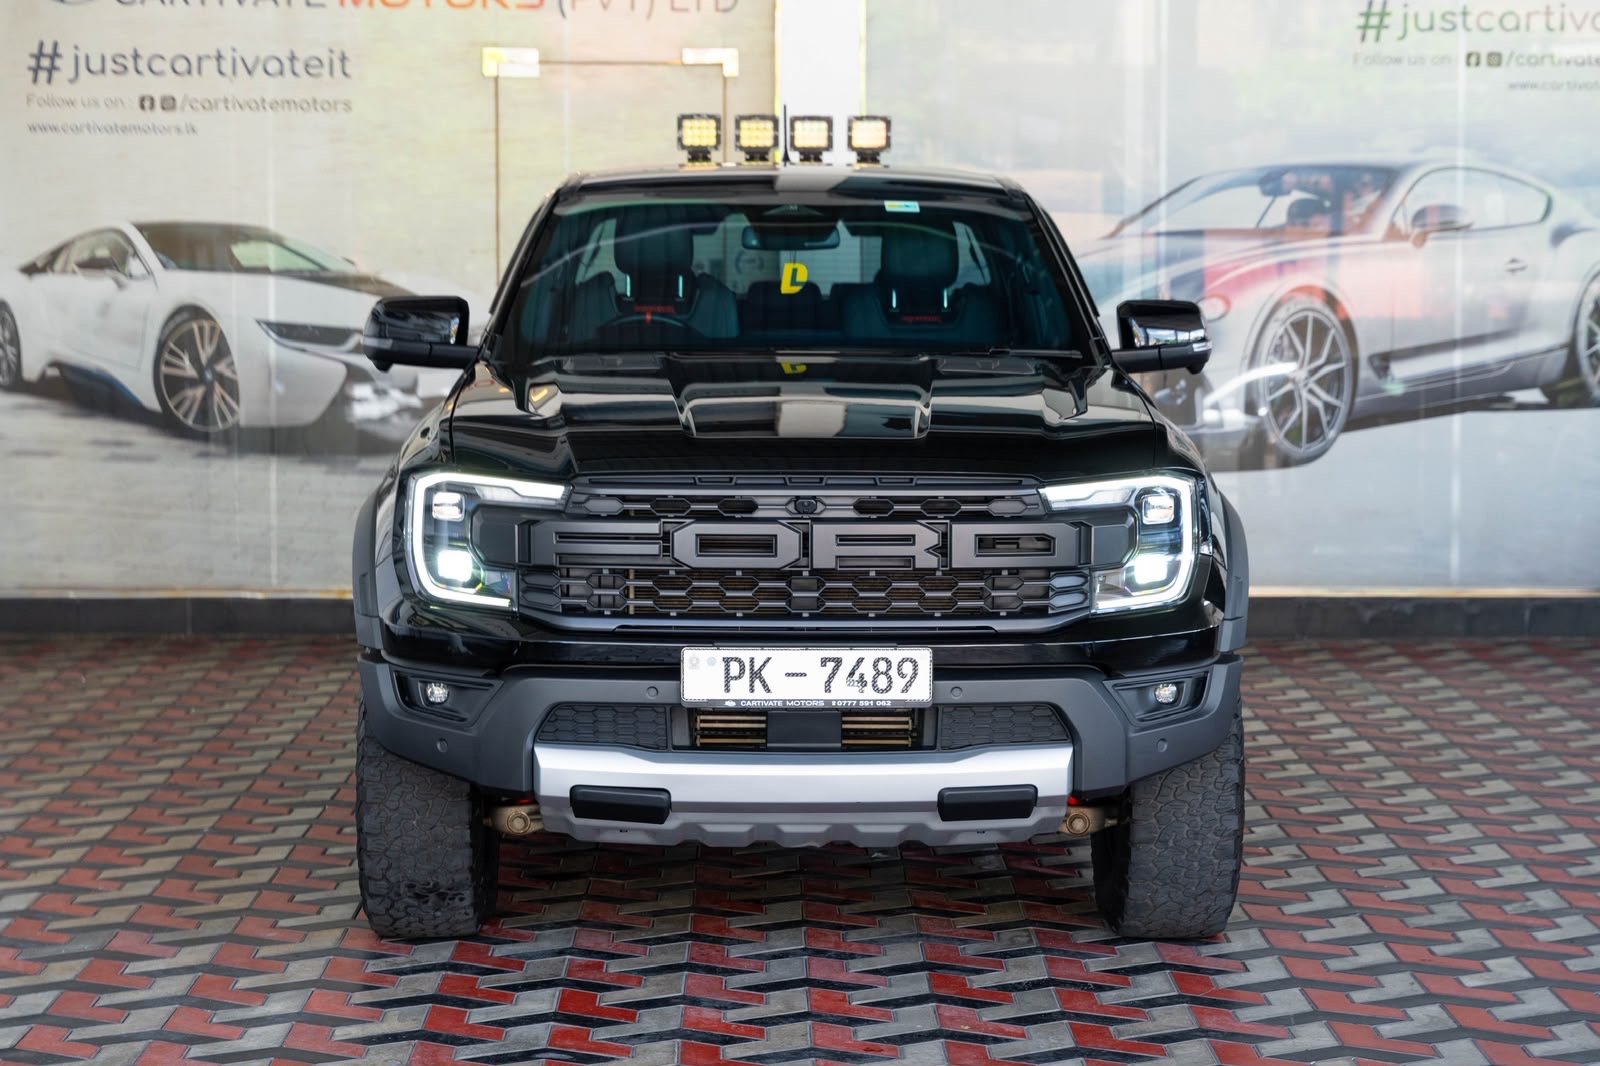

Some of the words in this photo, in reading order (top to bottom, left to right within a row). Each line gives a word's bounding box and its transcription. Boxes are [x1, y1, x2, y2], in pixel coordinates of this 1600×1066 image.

[27, 40, 353, 84] #justcartivateit
[26, 94, 76, 108] Follow
[525, 519, 1084, 570] FORD
[722, 656, 772, 694] PK
[819, 656, 920, 694] 7489
